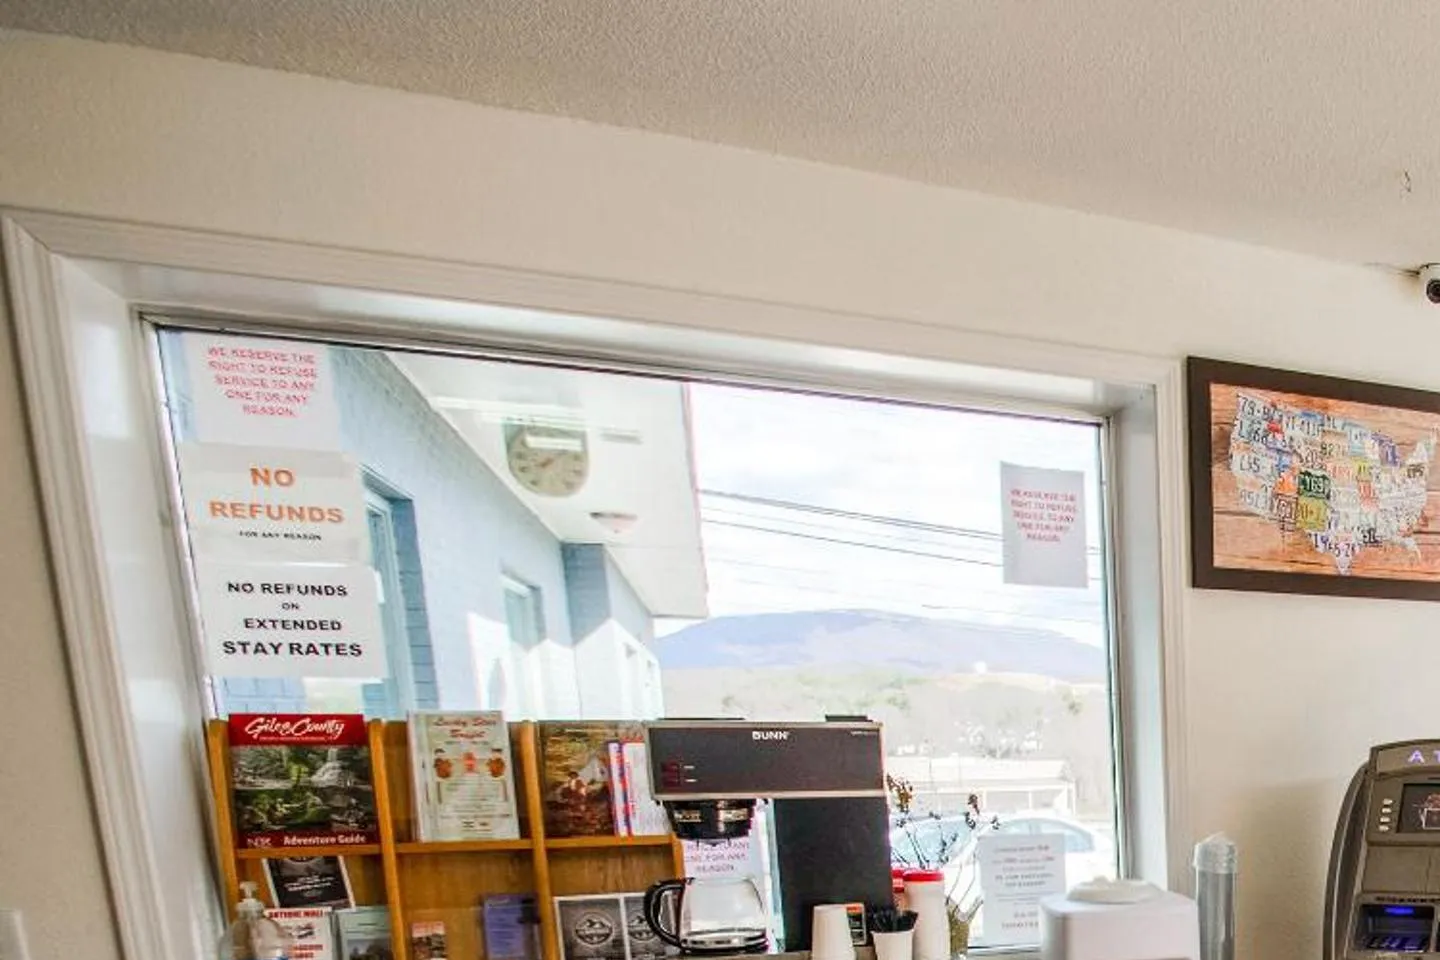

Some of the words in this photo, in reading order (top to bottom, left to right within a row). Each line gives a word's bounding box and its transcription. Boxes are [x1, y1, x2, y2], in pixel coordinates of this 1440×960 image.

[250, 467, 294, 487] NO
[209, 501, 345, 524] REFUNDS
[227, 582, 255, 594] NO
[260, 583, 348, 597] REFUNDS
[281, 602, 299, 611] ON
[243, 618, 342, 631] EXTENDED
[222, 640, 283, 655] STAY
[288, 642, 362, 657] RATES
[244, 717, 291, 740] Giles
[291, 716, 344, 740] County
[752, 730, 788, 741] BUNN
[283, 835, 336, 846] Adventure
[337, 833, 366, 845] Guide
